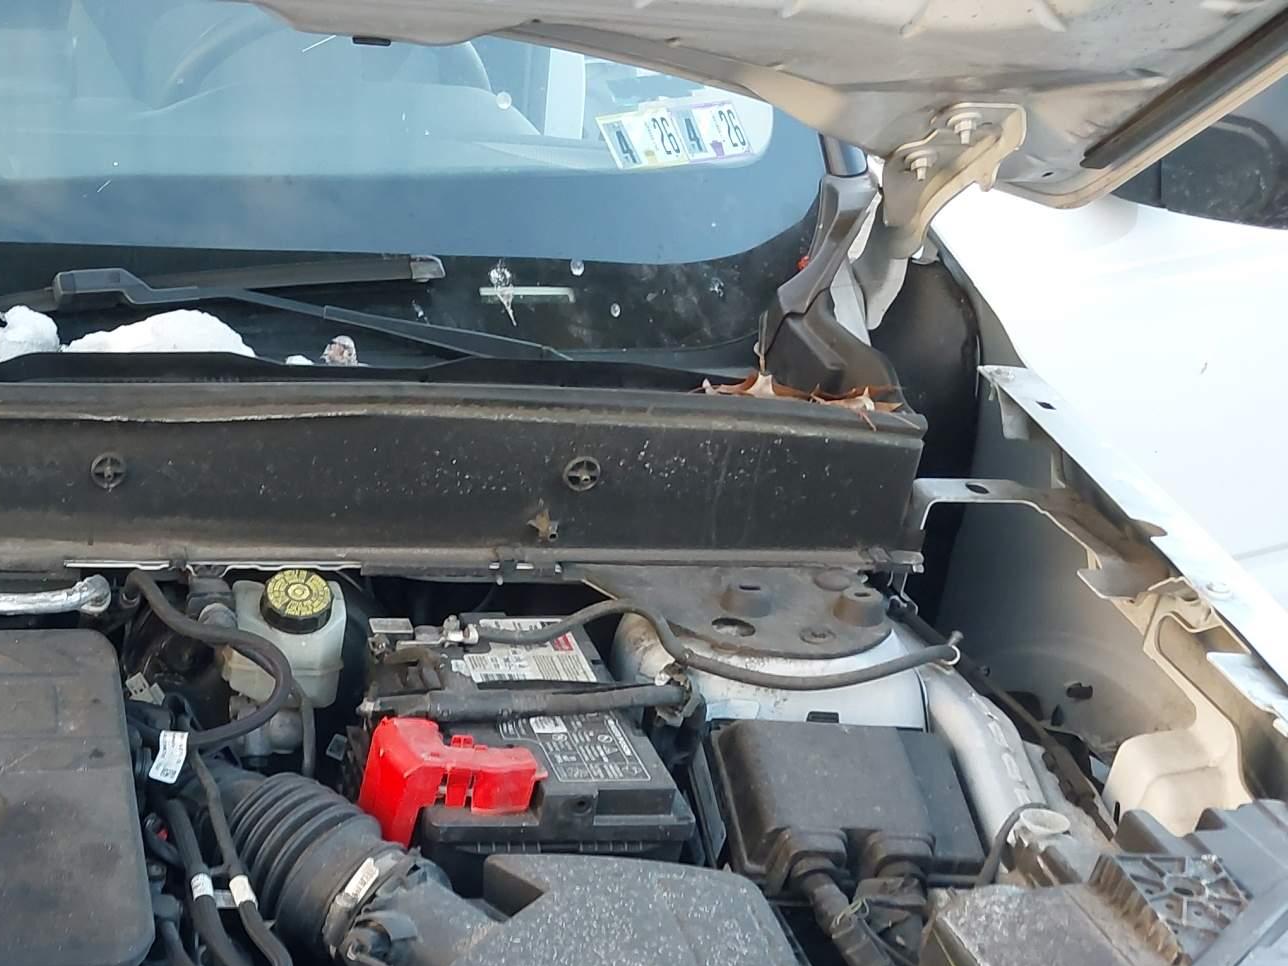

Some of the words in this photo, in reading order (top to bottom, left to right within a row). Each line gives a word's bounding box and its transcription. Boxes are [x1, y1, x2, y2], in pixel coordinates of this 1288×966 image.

[616, 130, 638, 164] 4
[651, 117, 681, 155] 26
[684, 118, 704, 153] 4
[718, 109, 746, 148] 26
